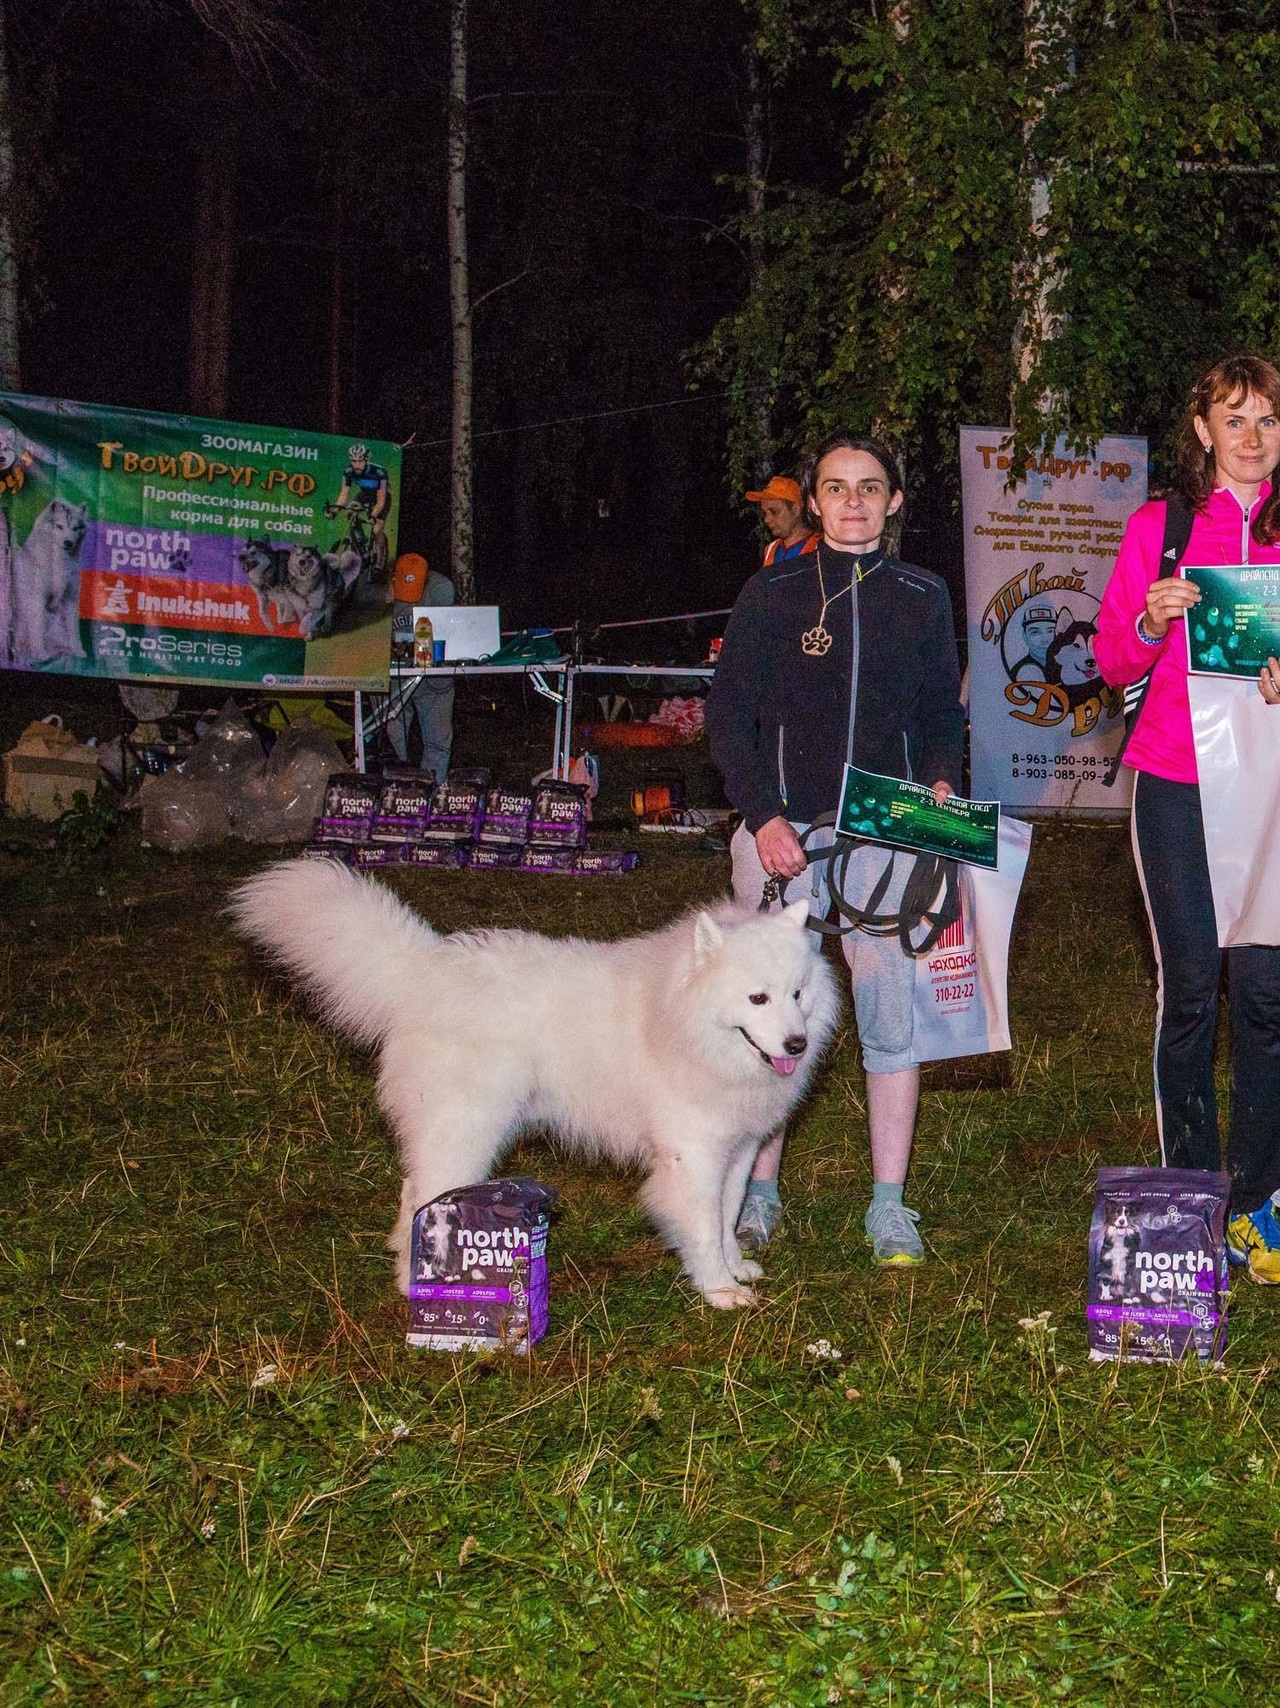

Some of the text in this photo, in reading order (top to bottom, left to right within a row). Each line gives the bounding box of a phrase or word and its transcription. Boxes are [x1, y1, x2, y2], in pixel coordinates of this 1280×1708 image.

[201, 434, 318, 461] ЗООМАГАЗИН
[976, 445, 1132, 483] ТвйДруг.рф
[143, 485, 314, 518] Профессиональные
[1017, 499, 1094, 515] Сухие корма
[171, 508, 313, 535] корма для собак
[988, 511, 1122, 529] Товары для животных
[105, 525, 191, 552] north
[1049, 529, 1091, 542] ручной
[993, 541, 1015, 551] для
[111, 546, 173, 571] paw
[1240, 569, 1280, 582] ДРАЙЛЕНД
[1263, 585, 1277, 596] 2-3
[137, 592, 250, 620] Inukshuk
[139, 651, 180, 662] HEALTH
[211, 658, 242, 667] FOOD
[341, 797, 373, 806] north
[395, 797, 427, 806] north
[448, 795, 477, 804] north
[448, 803, 471, 812] paw
[500, 795, 532, 806] north
[500, 802, 524, 812] paw
[550, 801, 581, 811] north
[920, 797, 934, 806] 2-3
[342, 805, 365, 814] paw
[396, 804, 419, 814] paw
[551, 809, 574, 818] paw
[928, 952, 977, 973] НАХОДКА
[935, 983, 974, 1003] 310-22-22
[457, 1227, 529, 1248] north
[462, 1247, 513, 1270] paw
[1135, 1250, 1213, 1272] north
[1140, 1269, 1197, 1293] paw
